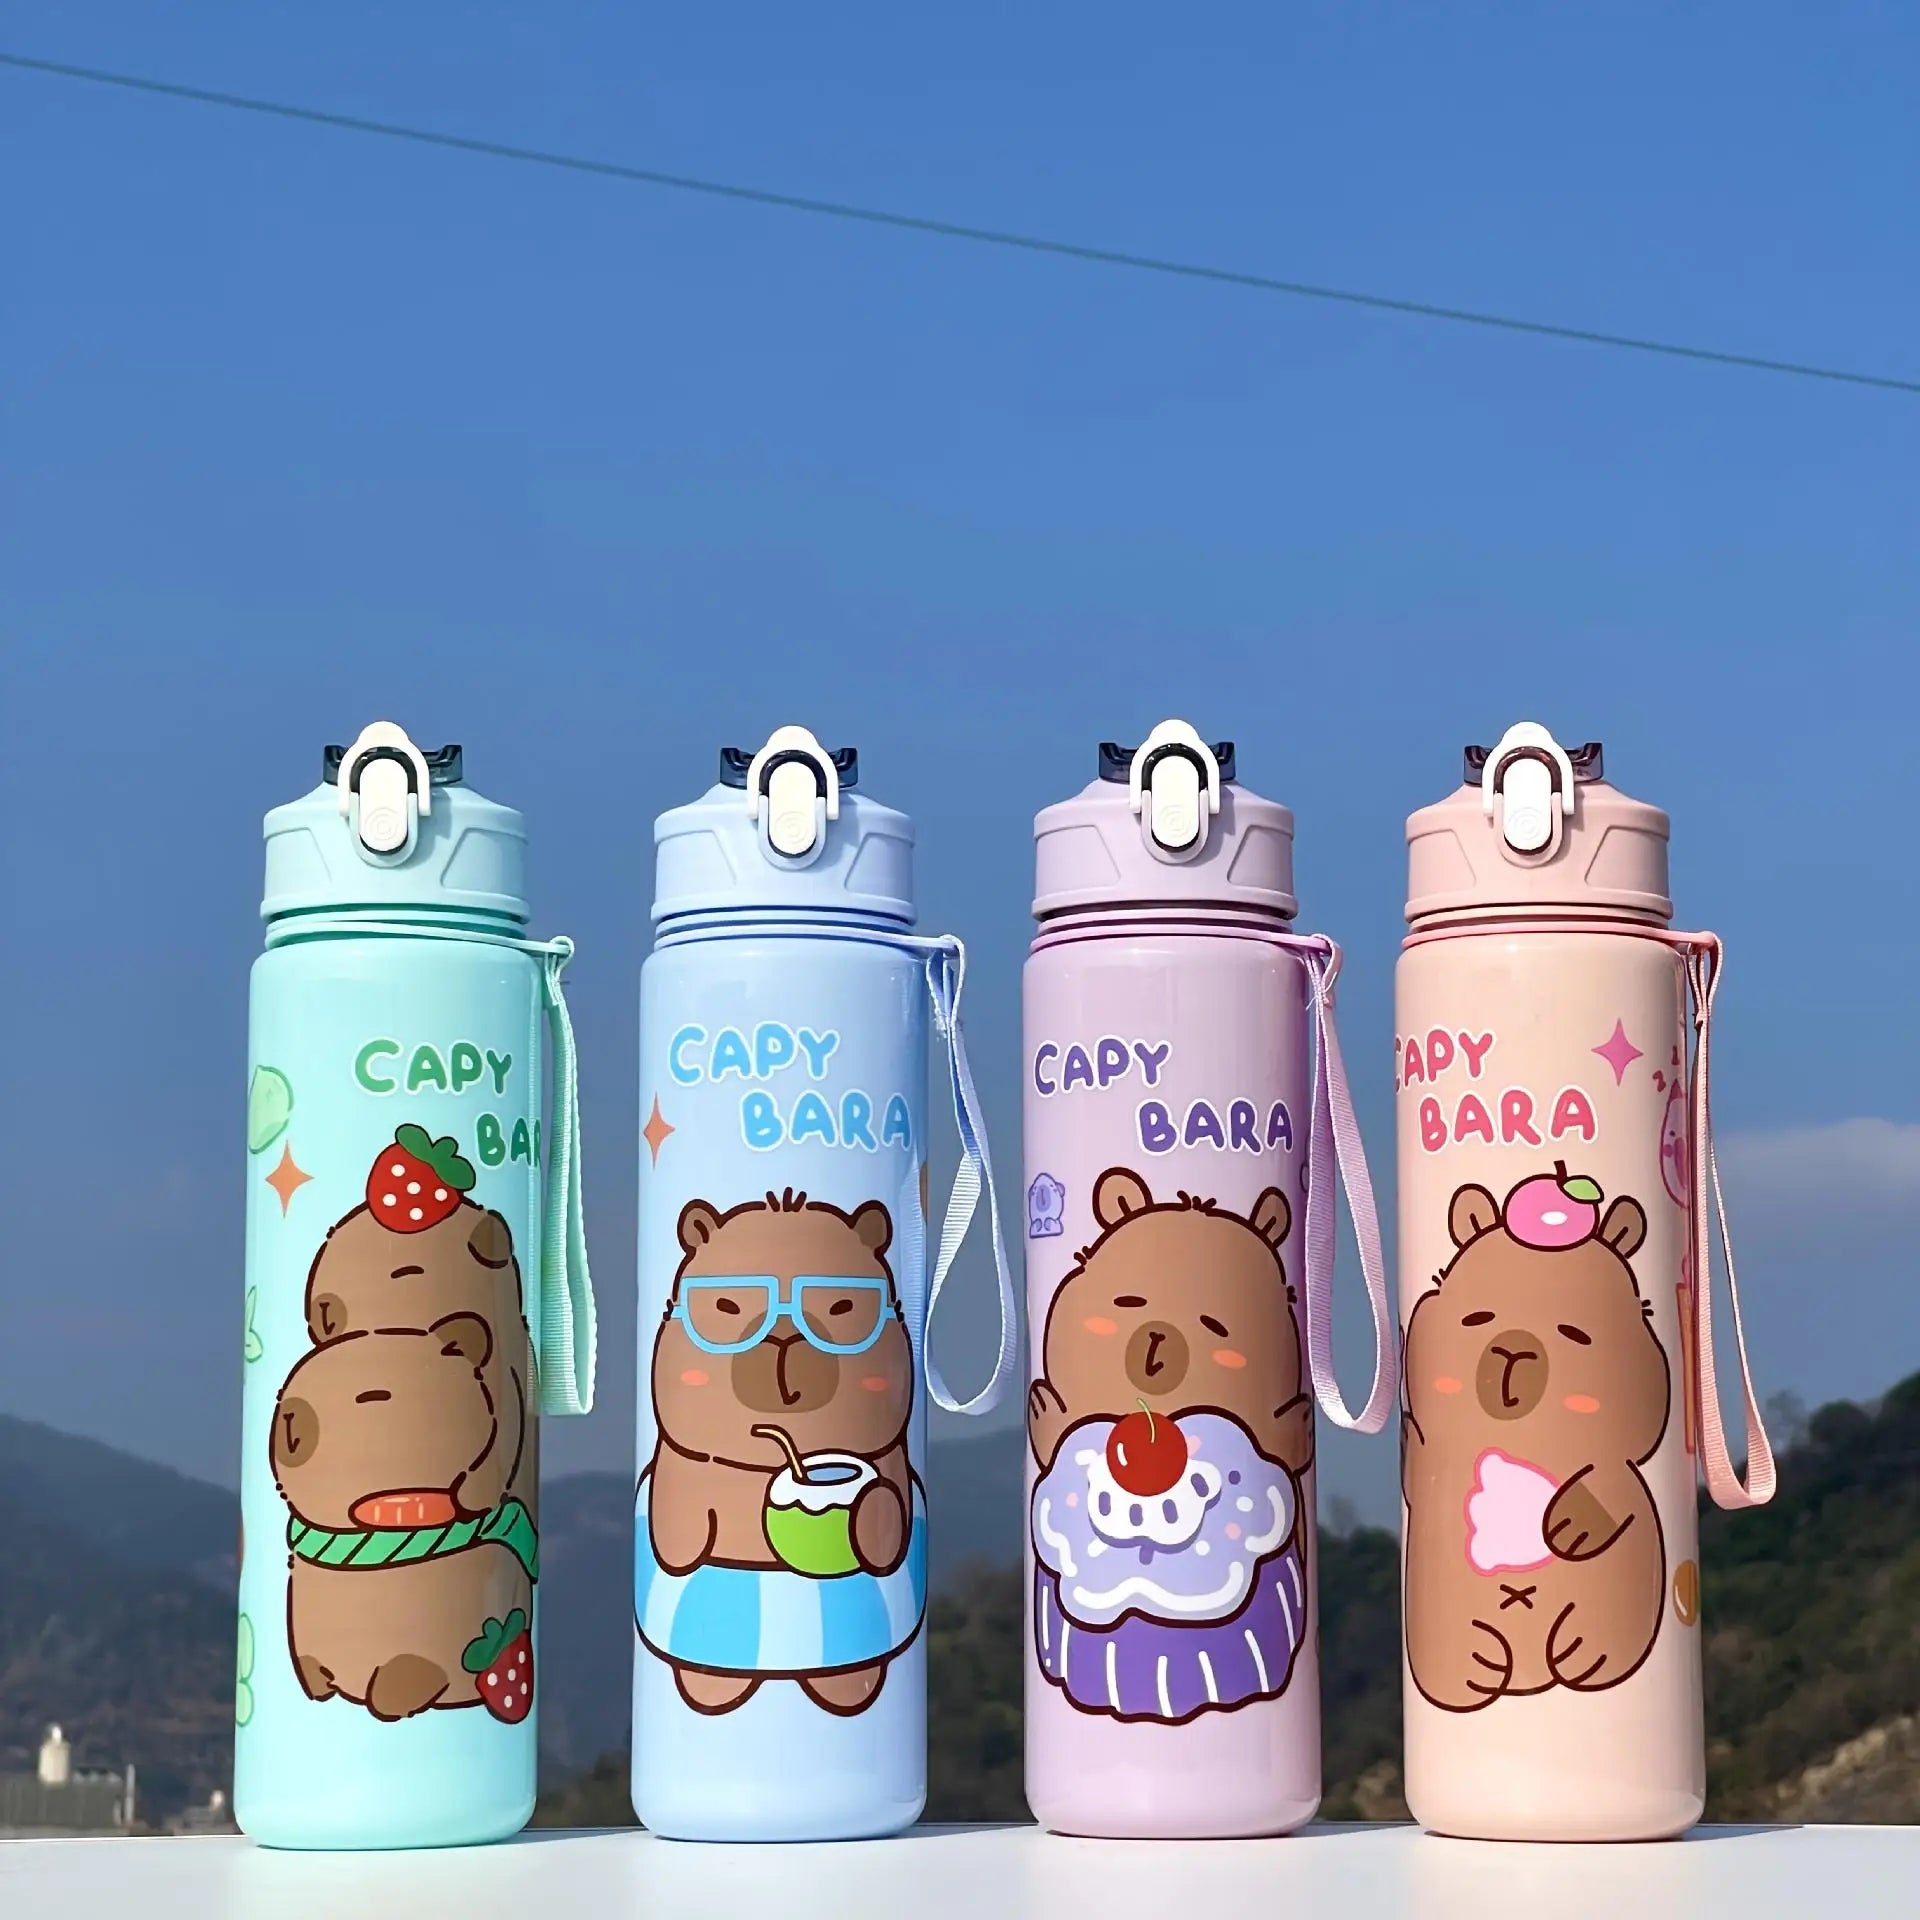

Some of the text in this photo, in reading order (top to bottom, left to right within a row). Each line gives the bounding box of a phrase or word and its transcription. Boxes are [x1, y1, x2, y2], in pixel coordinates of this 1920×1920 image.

[354, 1038, 512, 1095] CAPY
[669, 1022, 839, 1085] CAPY
[1034, 1037, 1171, 1096] CAPY
[741, 1090, 912, 1151] BARA
[1137, 1099, 1293, 1154] BARA
[1419, 1087, 1597, 1151] BARA
